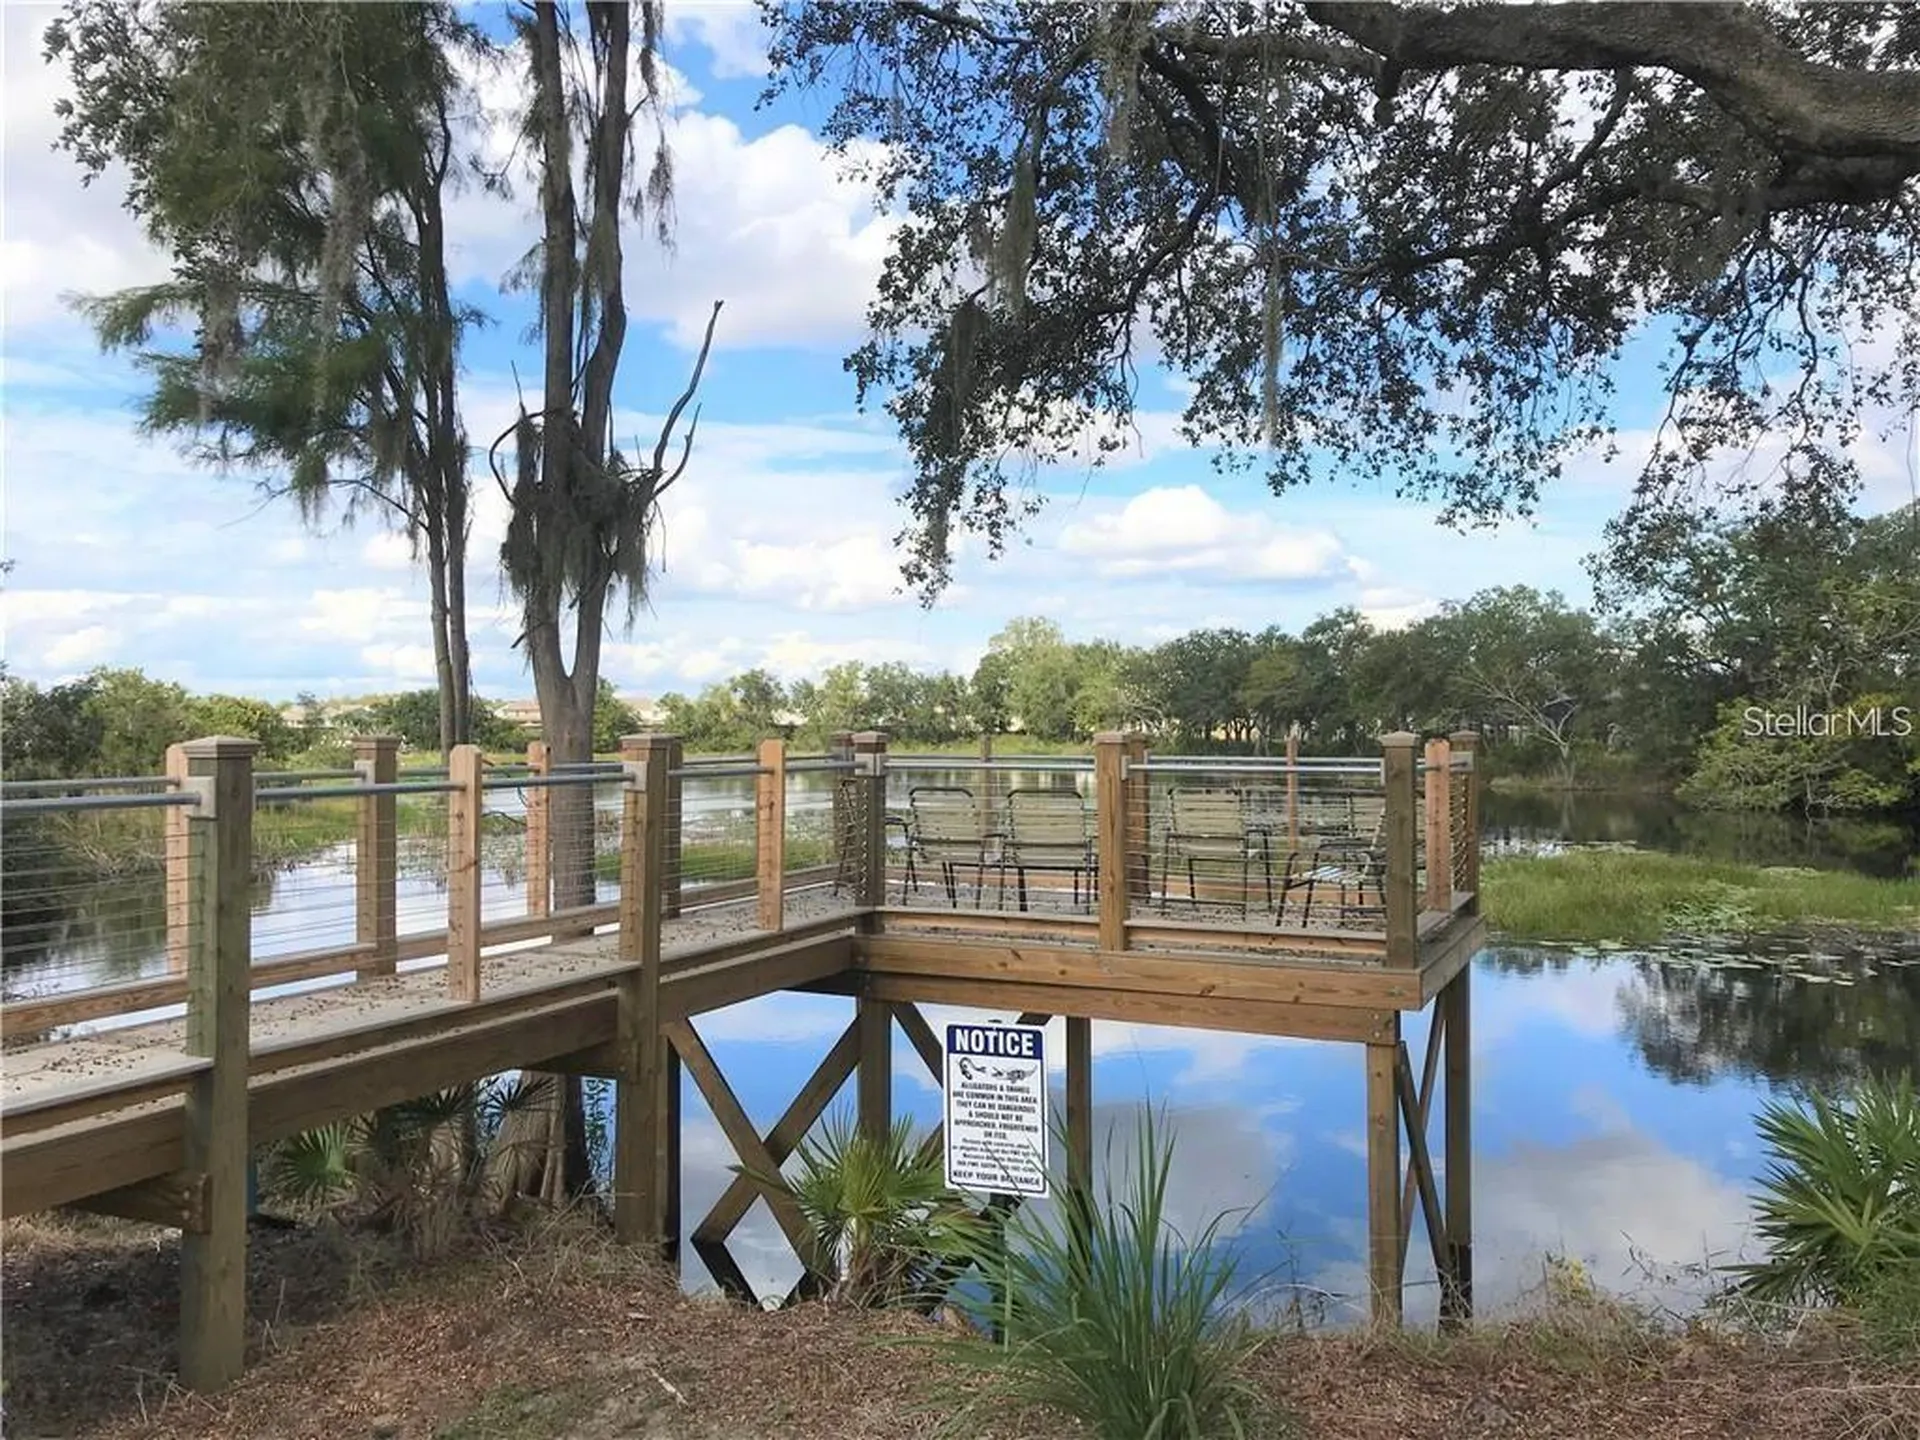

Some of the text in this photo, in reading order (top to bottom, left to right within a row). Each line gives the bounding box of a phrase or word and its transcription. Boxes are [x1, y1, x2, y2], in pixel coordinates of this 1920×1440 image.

[955, 1028, 1034, 1056] NOTICE
[966, 1092, 995, 1100] COMMON
[1005, 1094, 1019, 1102] THIS
[956, 1100, 971, 1108] THEY
[973, 1101, 986, 1109] CAN
[998, 1103, 1036, 1114] DANGEROUS
[975, 1111, 999, 1120] SHOULD
[1001, 1113, 1013, 1121] NOT
[1015, 1114, 1023, 1122] BE
[953, 1170, 973, 1178] KEEP
[976, 1172, 998, 1181] YOUR
